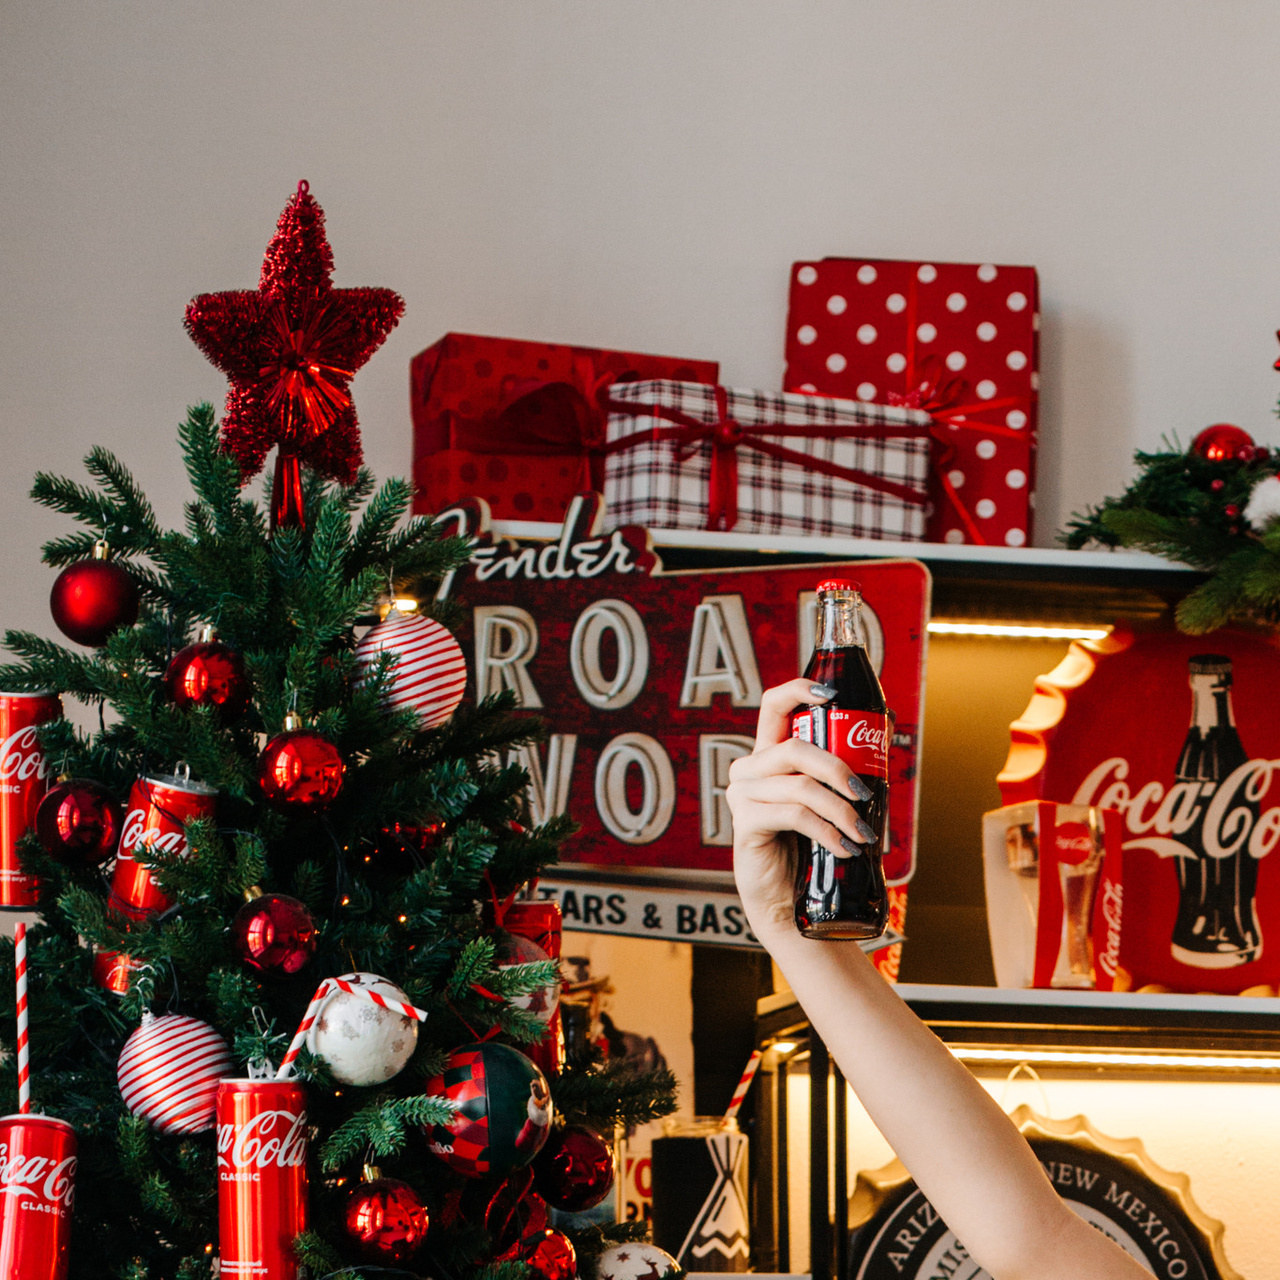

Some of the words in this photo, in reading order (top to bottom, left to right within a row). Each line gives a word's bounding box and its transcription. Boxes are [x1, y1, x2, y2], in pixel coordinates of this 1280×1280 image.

[642, 902, 663, 929] &
[220, 1172, 261, 1182] CLASSIC
[21, 1201, 66, 1218] CLASSIC
[887, 1202, 940, 1272] ARIZ
[1104, 1180, 1188, 1280] MEXICO
